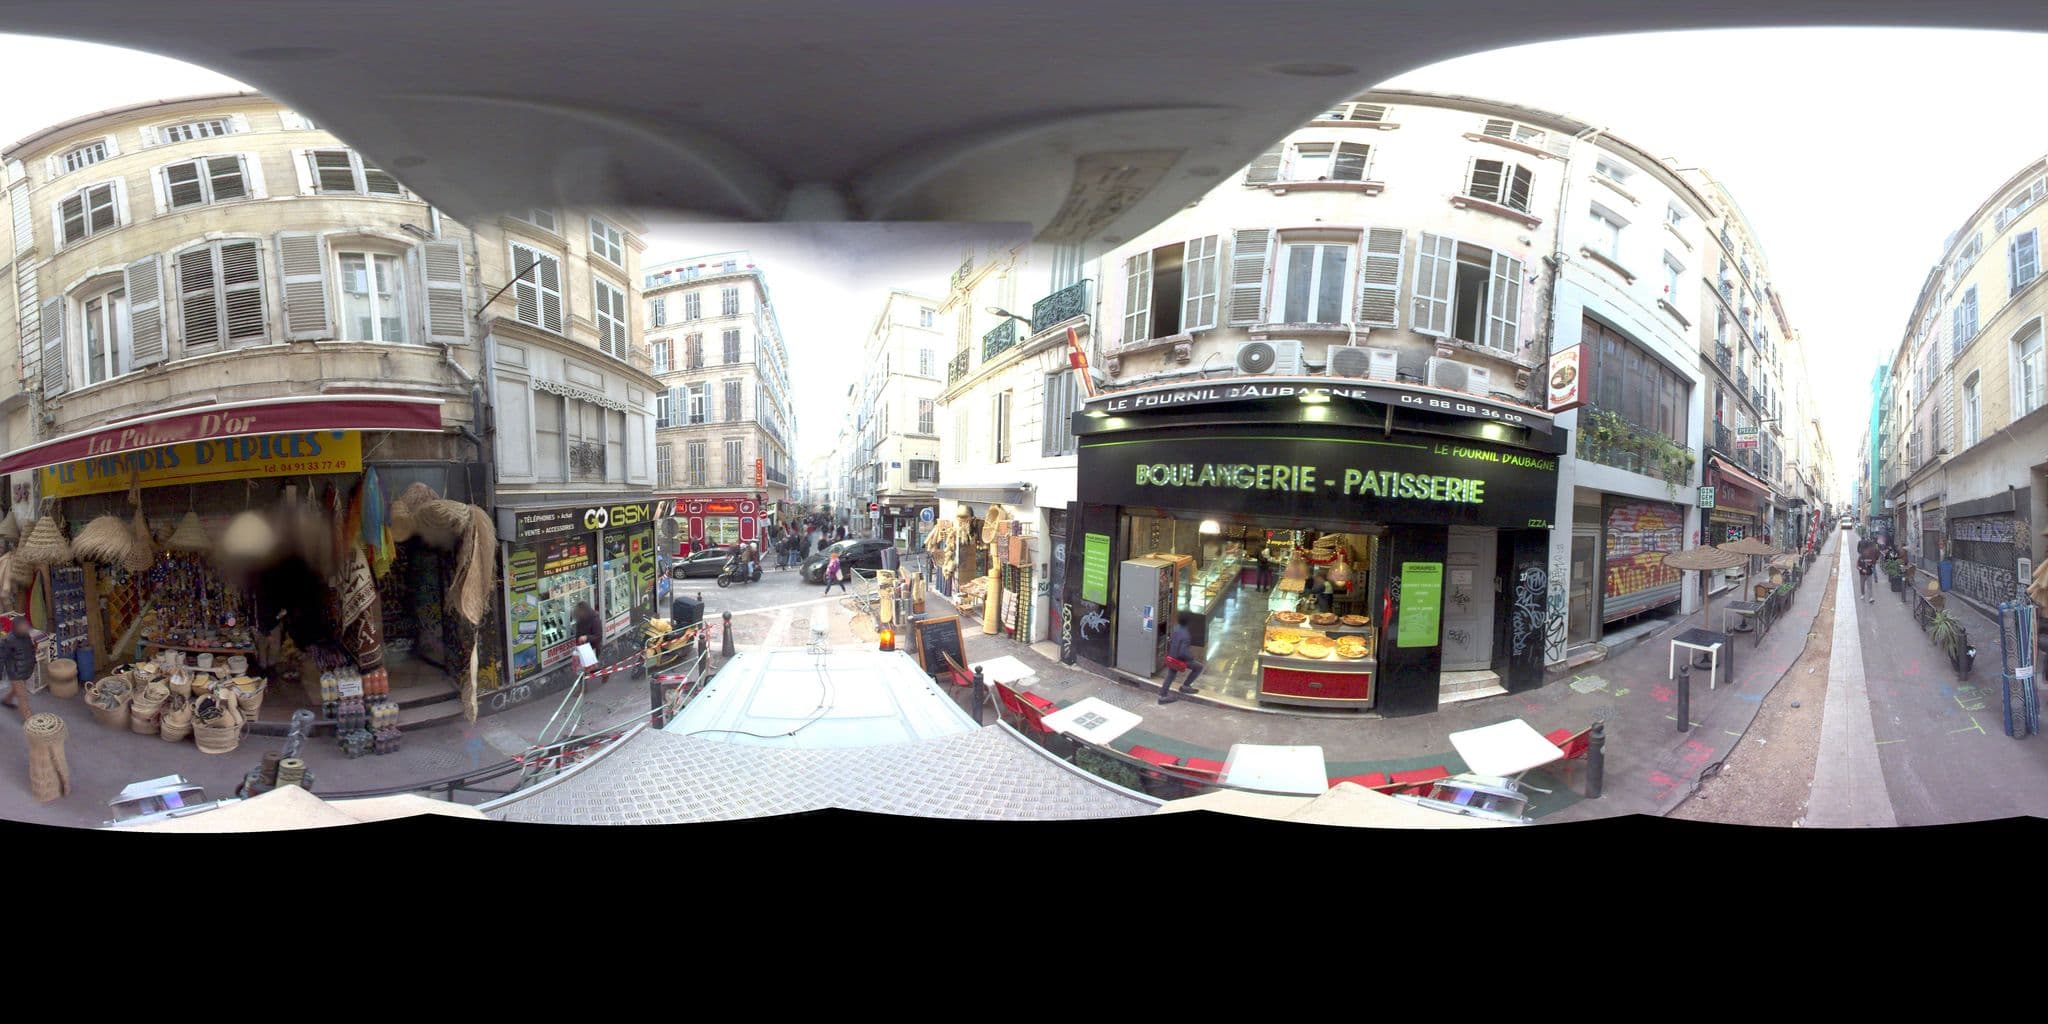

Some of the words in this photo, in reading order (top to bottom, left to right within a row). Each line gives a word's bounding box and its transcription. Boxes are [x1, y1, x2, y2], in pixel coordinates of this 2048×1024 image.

[1107, 400, 1127, 412] LE
[1135, 389, 1221, 407] FOURNIL
[1401, 395, 1423, 404] 04
[1429, 400, 1450, 409] 88
[1456, 405, 1476, 413] 08
[1482, 409, 1500, 417] 36
[1505, 414, 1522, 422] 09
[88, 436, 112, 455] La
[201, 412, 256, 437] D'or
[1434, 444, 1448, 454] LE
[1453, 447, 1499, 462] FOURNIL
[1502, 454, 1555, 471] D'AUBAGNE
[1136, 463, 1316, 492] BOULANGERIE
[1344, 468, 1485, 504] PATISSERIE
[610, 504, 650, 526] GSM
[524, 528, 541, 537] VENTE
